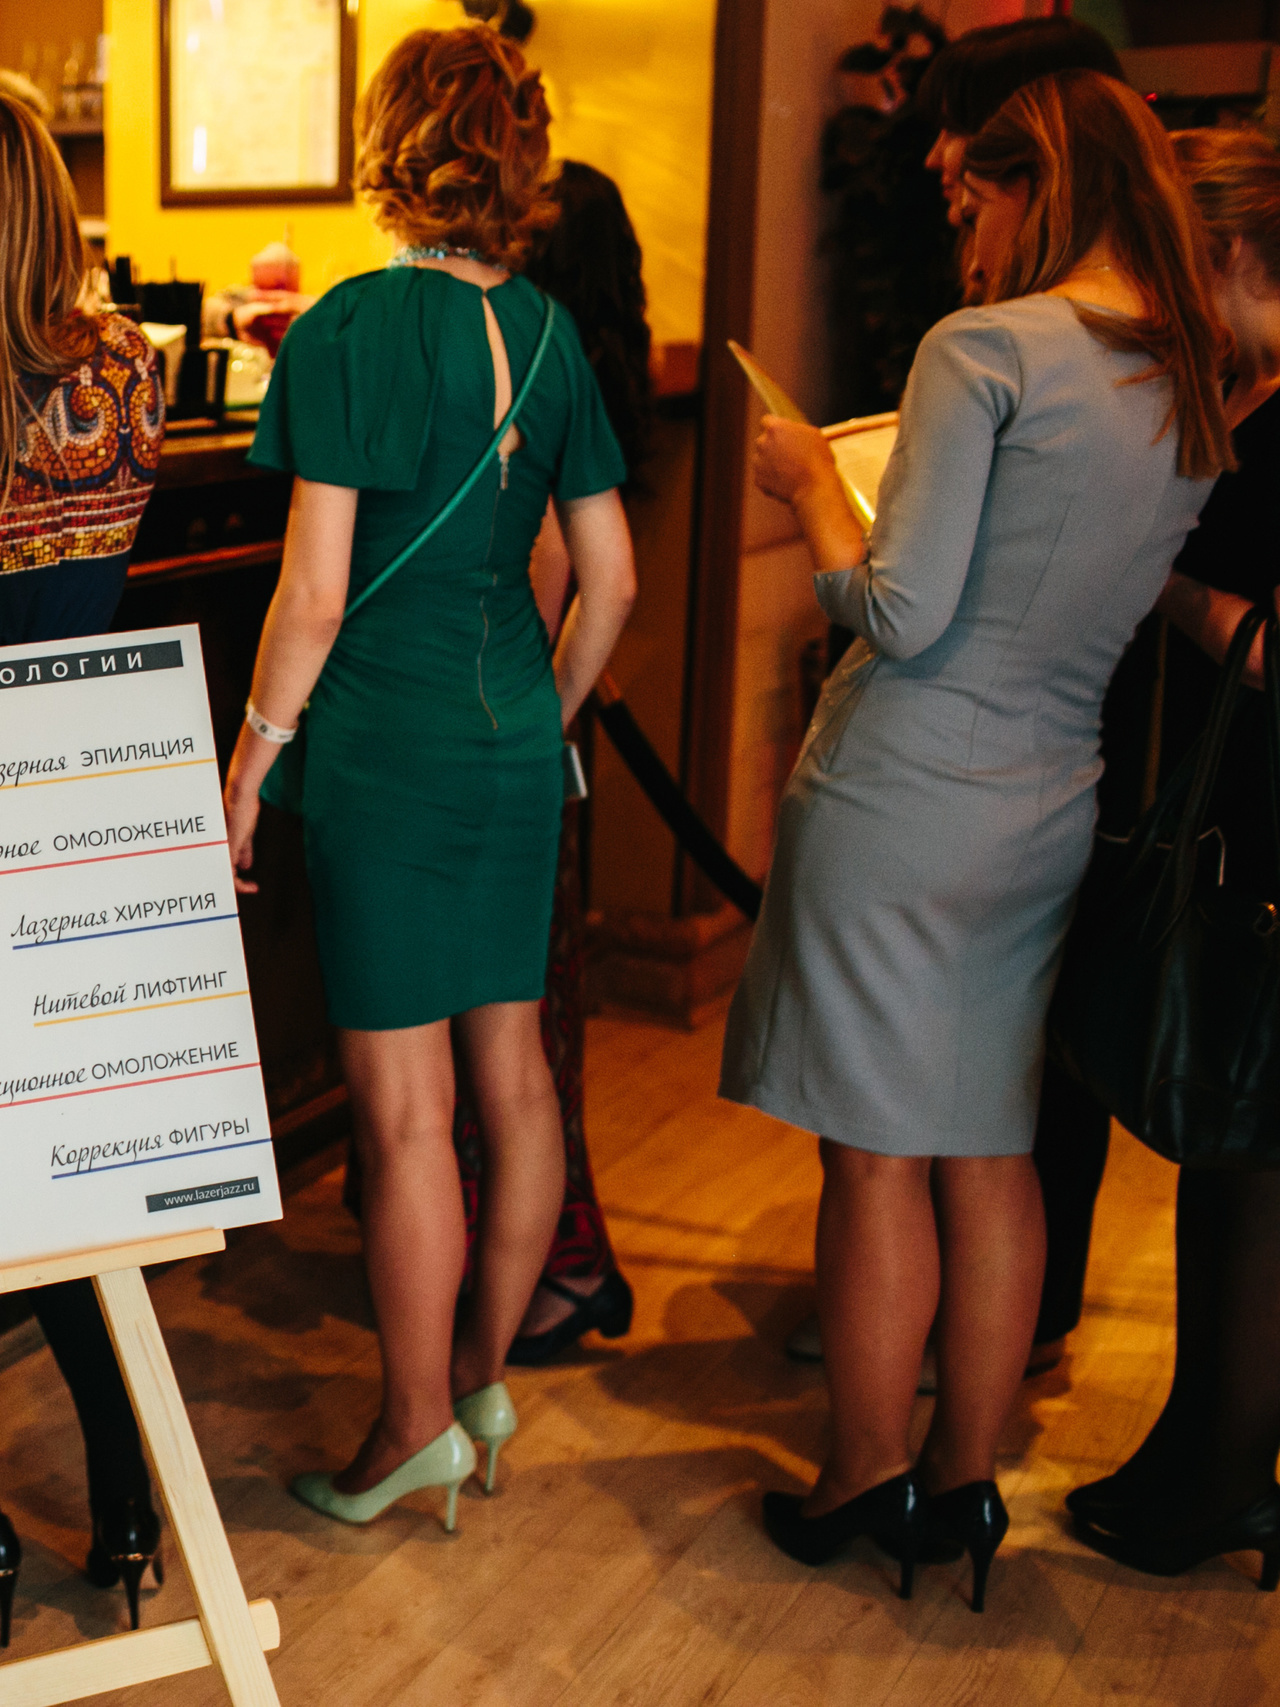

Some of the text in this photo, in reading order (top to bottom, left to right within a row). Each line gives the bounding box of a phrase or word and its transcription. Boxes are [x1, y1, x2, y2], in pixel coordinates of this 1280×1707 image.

[80, 737, 194, 767] ЭПИЛЯЦИЯ
[53, 815, 206, 852] ОМОЛОЖЕНИЕ
[10, 892, 217, 944] Лазерная ХИРУРГИЯ
[33, 971, 228, 1016] Нитевой ЛИФТИНГ
[91, 1041, 240, 1080] ОМОЛОЖЕНИЕ
[51, 1118, 251, 1174] Коррекция ФИГУРЫ
[163, 1180, 256, 1207] www.lazerjazz.ru
